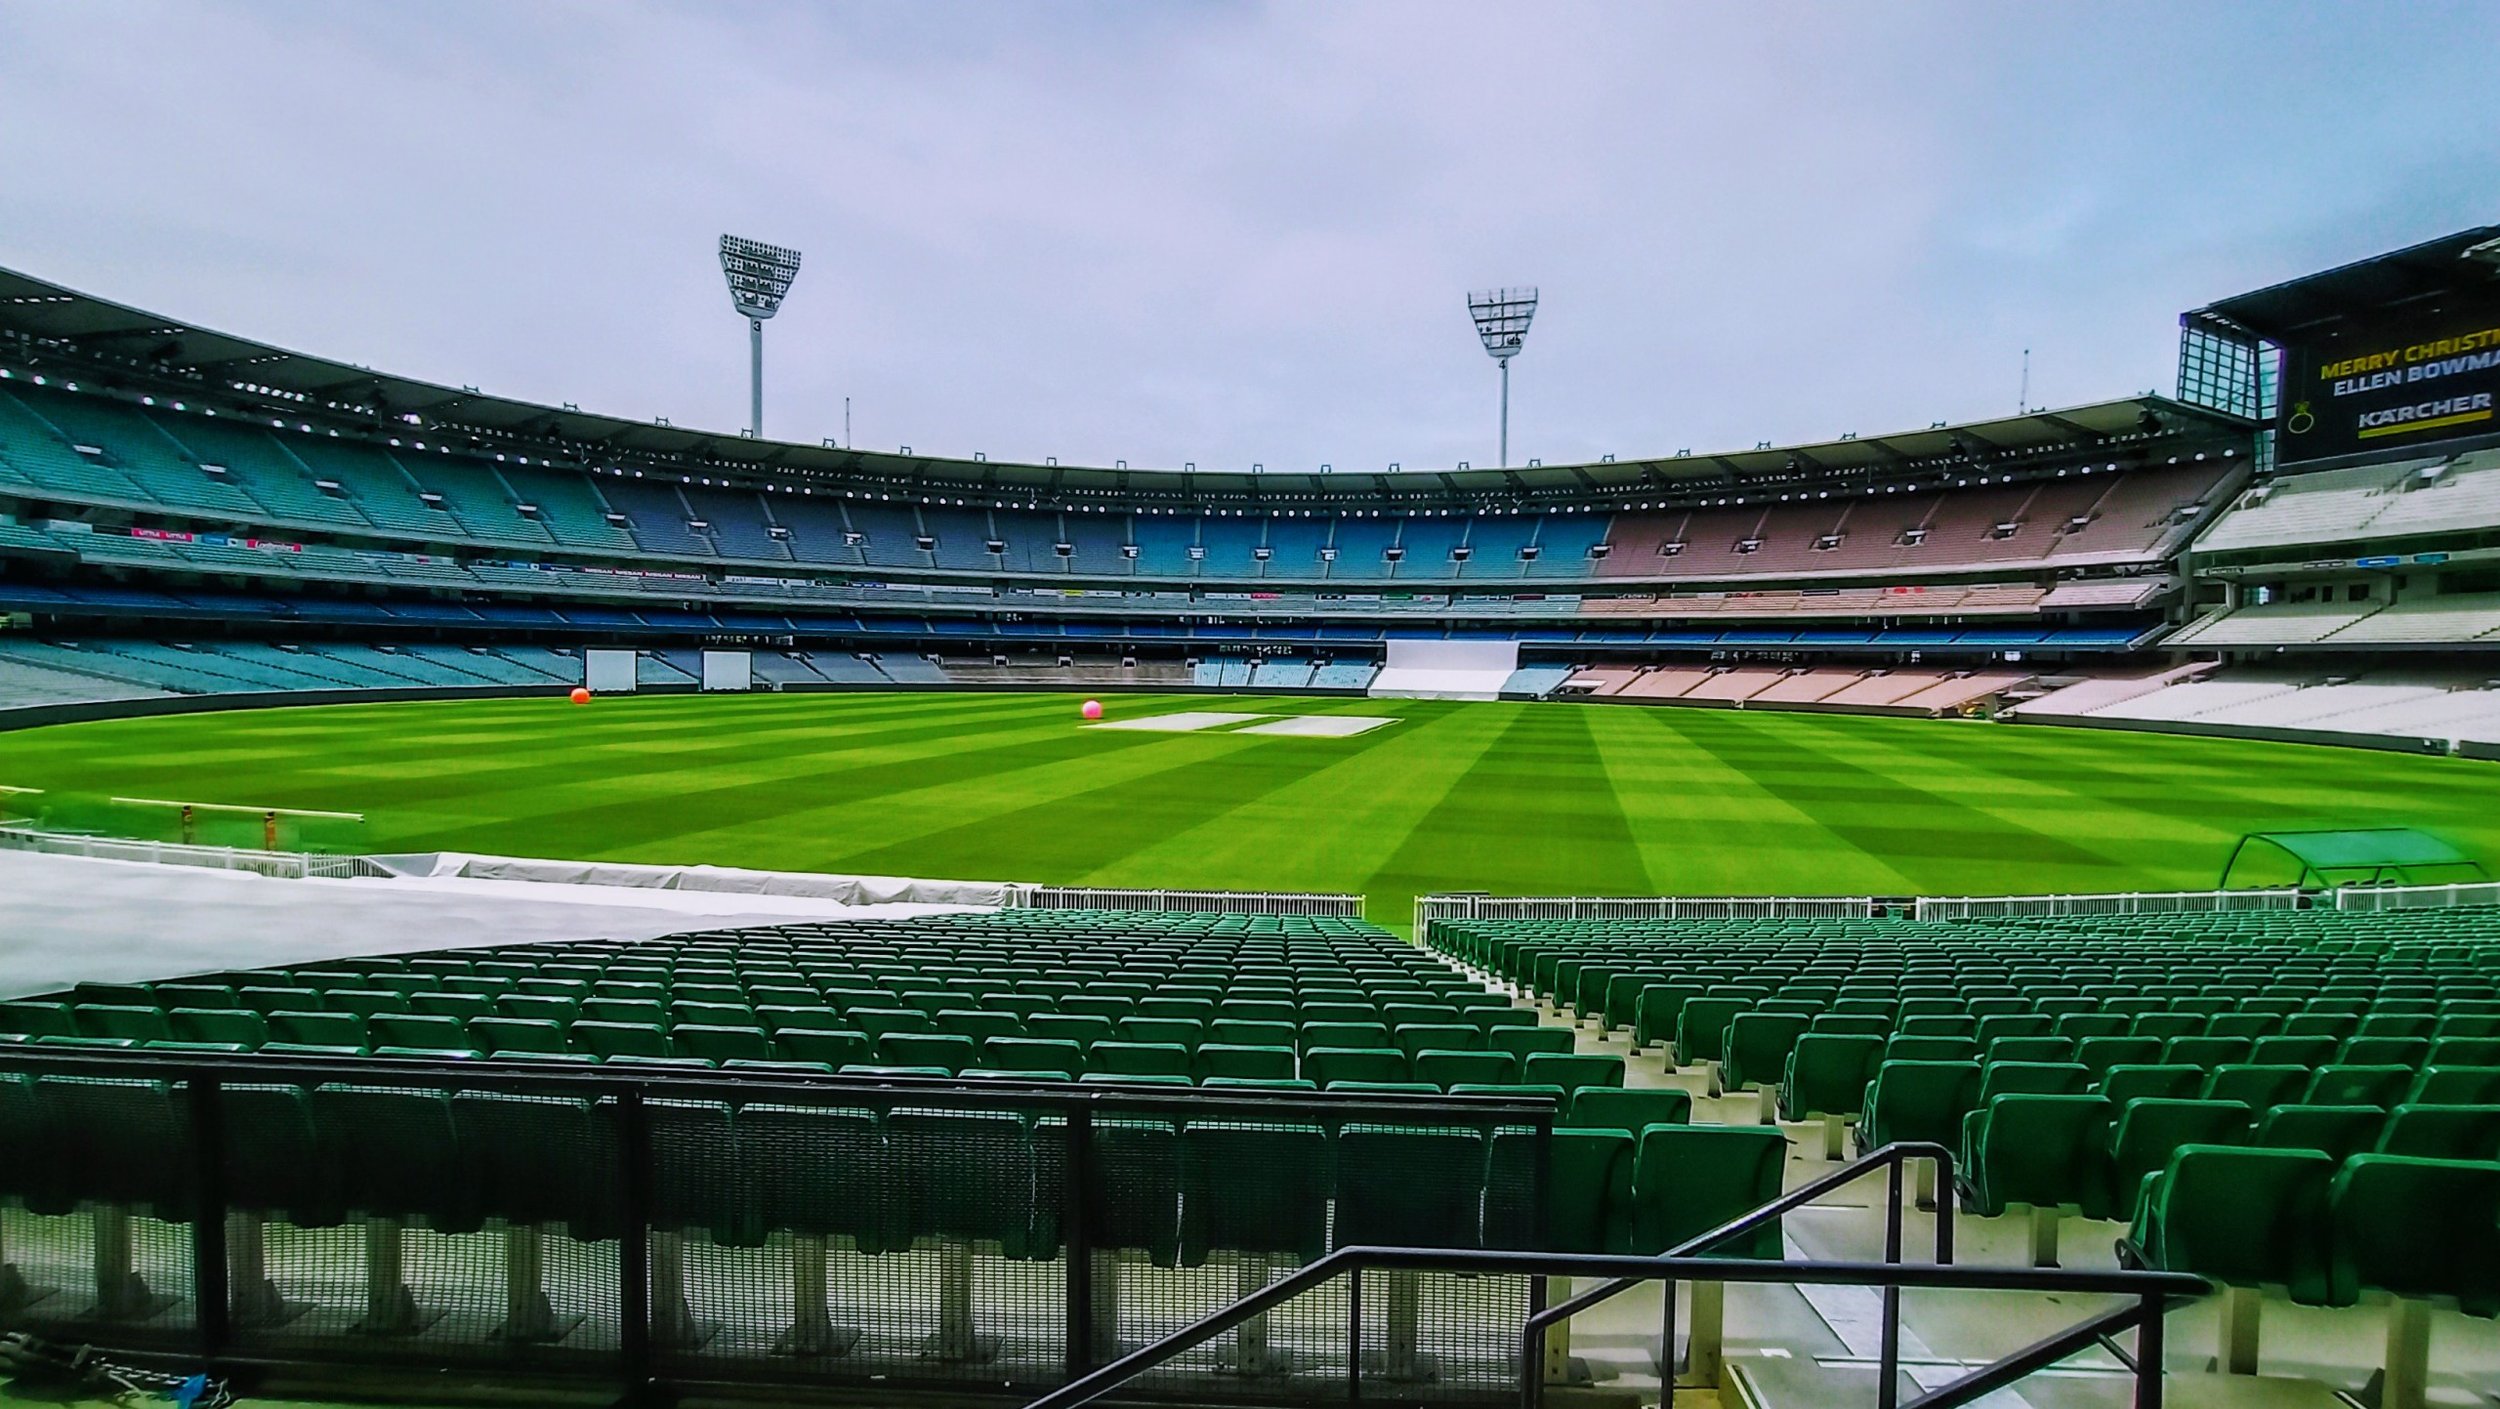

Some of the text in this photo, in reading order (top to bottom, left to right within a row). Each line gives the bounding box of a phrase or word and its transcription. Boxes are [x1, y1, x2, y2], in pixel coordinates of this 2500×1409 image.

[2320, 349, 2400, 380] MERRY
[2334, 370, 2401, 396] ELLEN
[2358, 393, 2492, 428] KÄRCHER
